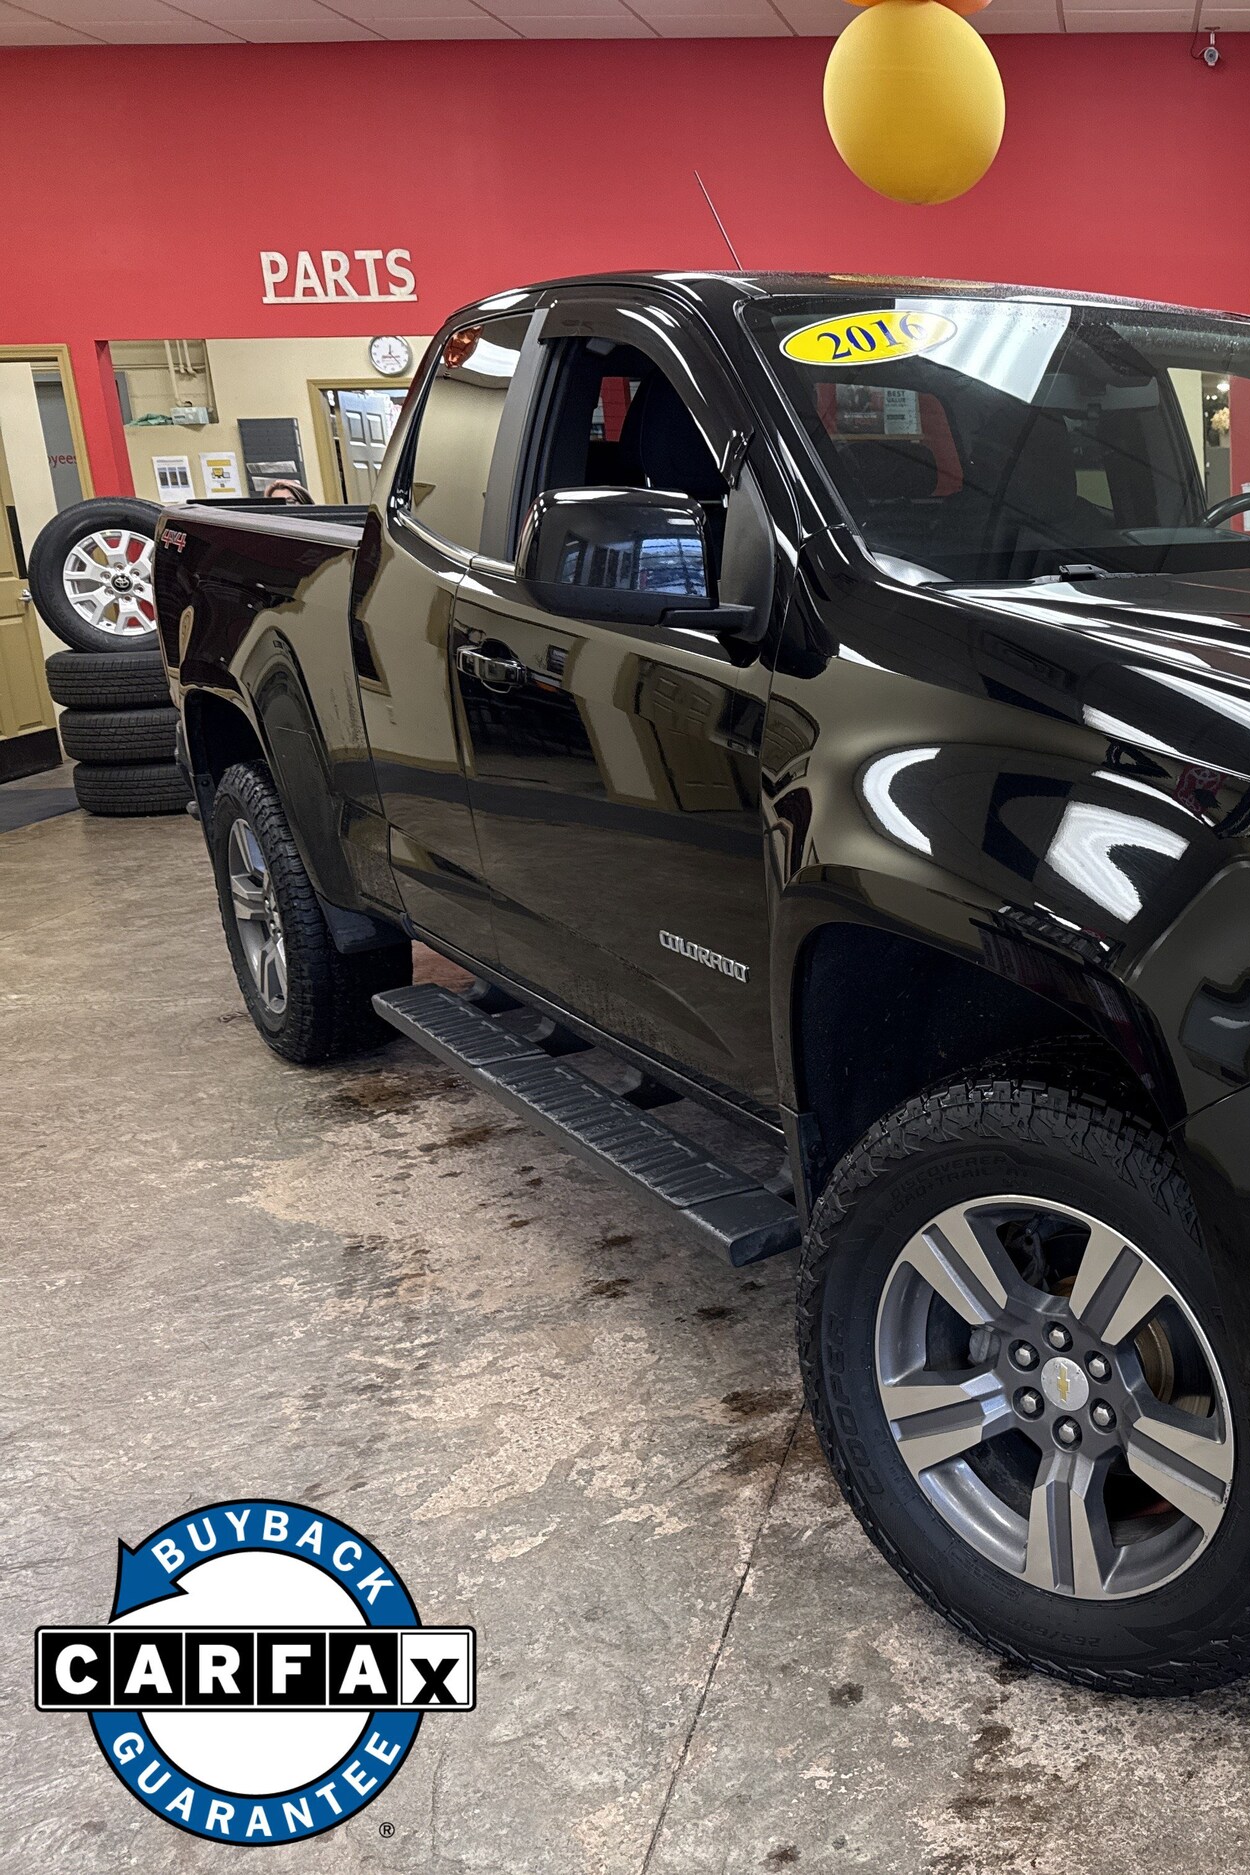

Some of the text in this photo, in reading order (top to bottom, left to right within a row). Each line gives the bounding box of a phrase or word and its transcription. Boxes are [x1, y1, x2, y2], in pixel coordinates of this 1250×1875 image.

[260, 248, 416, 299] PARTS
[817, 313, 928, 360] 2016
[887, 390, 905, 398] BEST
[659, 929, 750, 983] COLORADO
